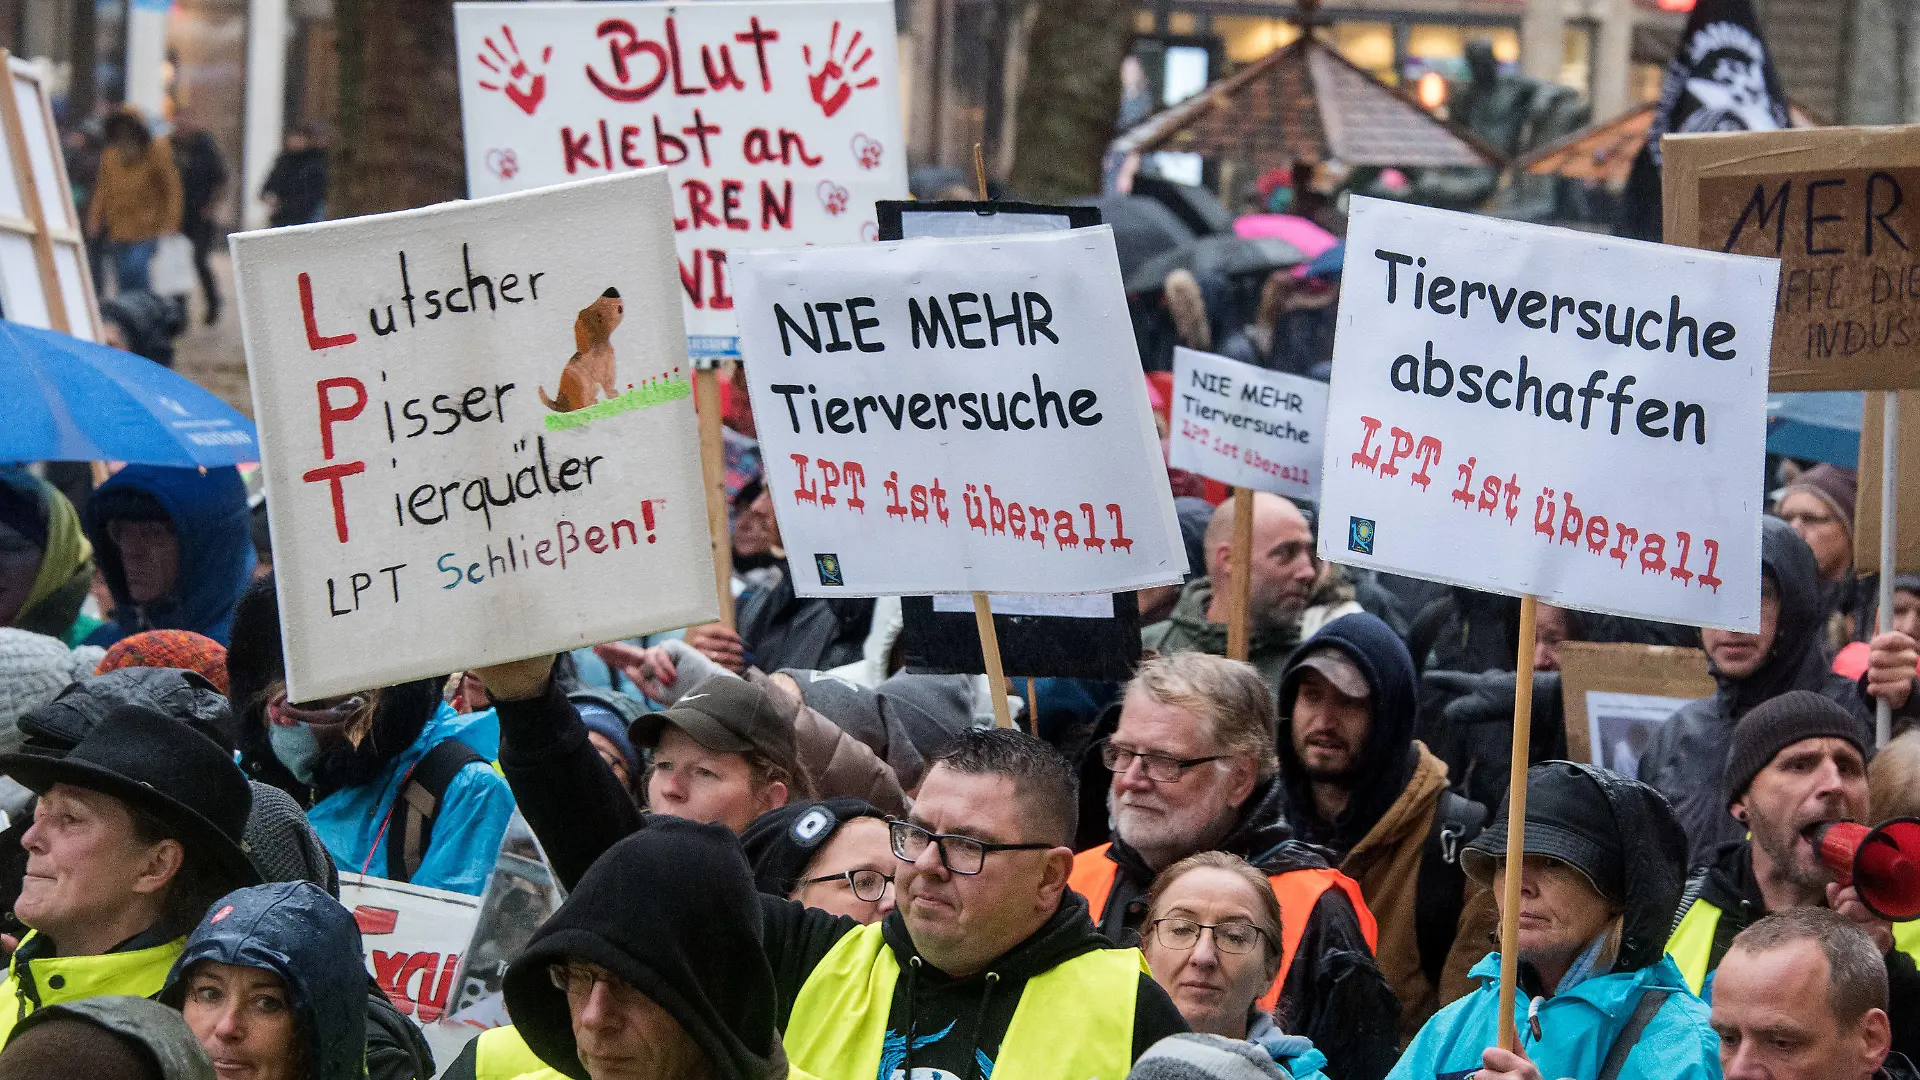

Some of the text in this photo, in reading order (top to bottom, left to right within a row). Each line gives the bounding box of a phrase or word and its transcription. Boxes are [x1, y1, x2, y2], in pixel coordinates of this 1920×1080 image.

[743, 127, 823, 167] an
[297, 242, 546, 350] Lutscher
[774, 292, 1059, 356] NIE MEHR
[1374, 249, 1737, 361] Tierversuche
[317, 371, 516, 460] Pisser
[771, 373, 1103, 434] Tierversuche
[1183, 394, 1310, 444] Tierversuche
[1191, 369, 1303, 414] NIE MEHR
[1390, 340, 1706, 445] abschaffen
[303, 435, 605, 543] Tierquäler
[790, 453, 1133, 554] LPT ist überall
[1351, 415, 1724, 594] LPT ist überall
[327, 499, 661, 617] LPT Schließen!
